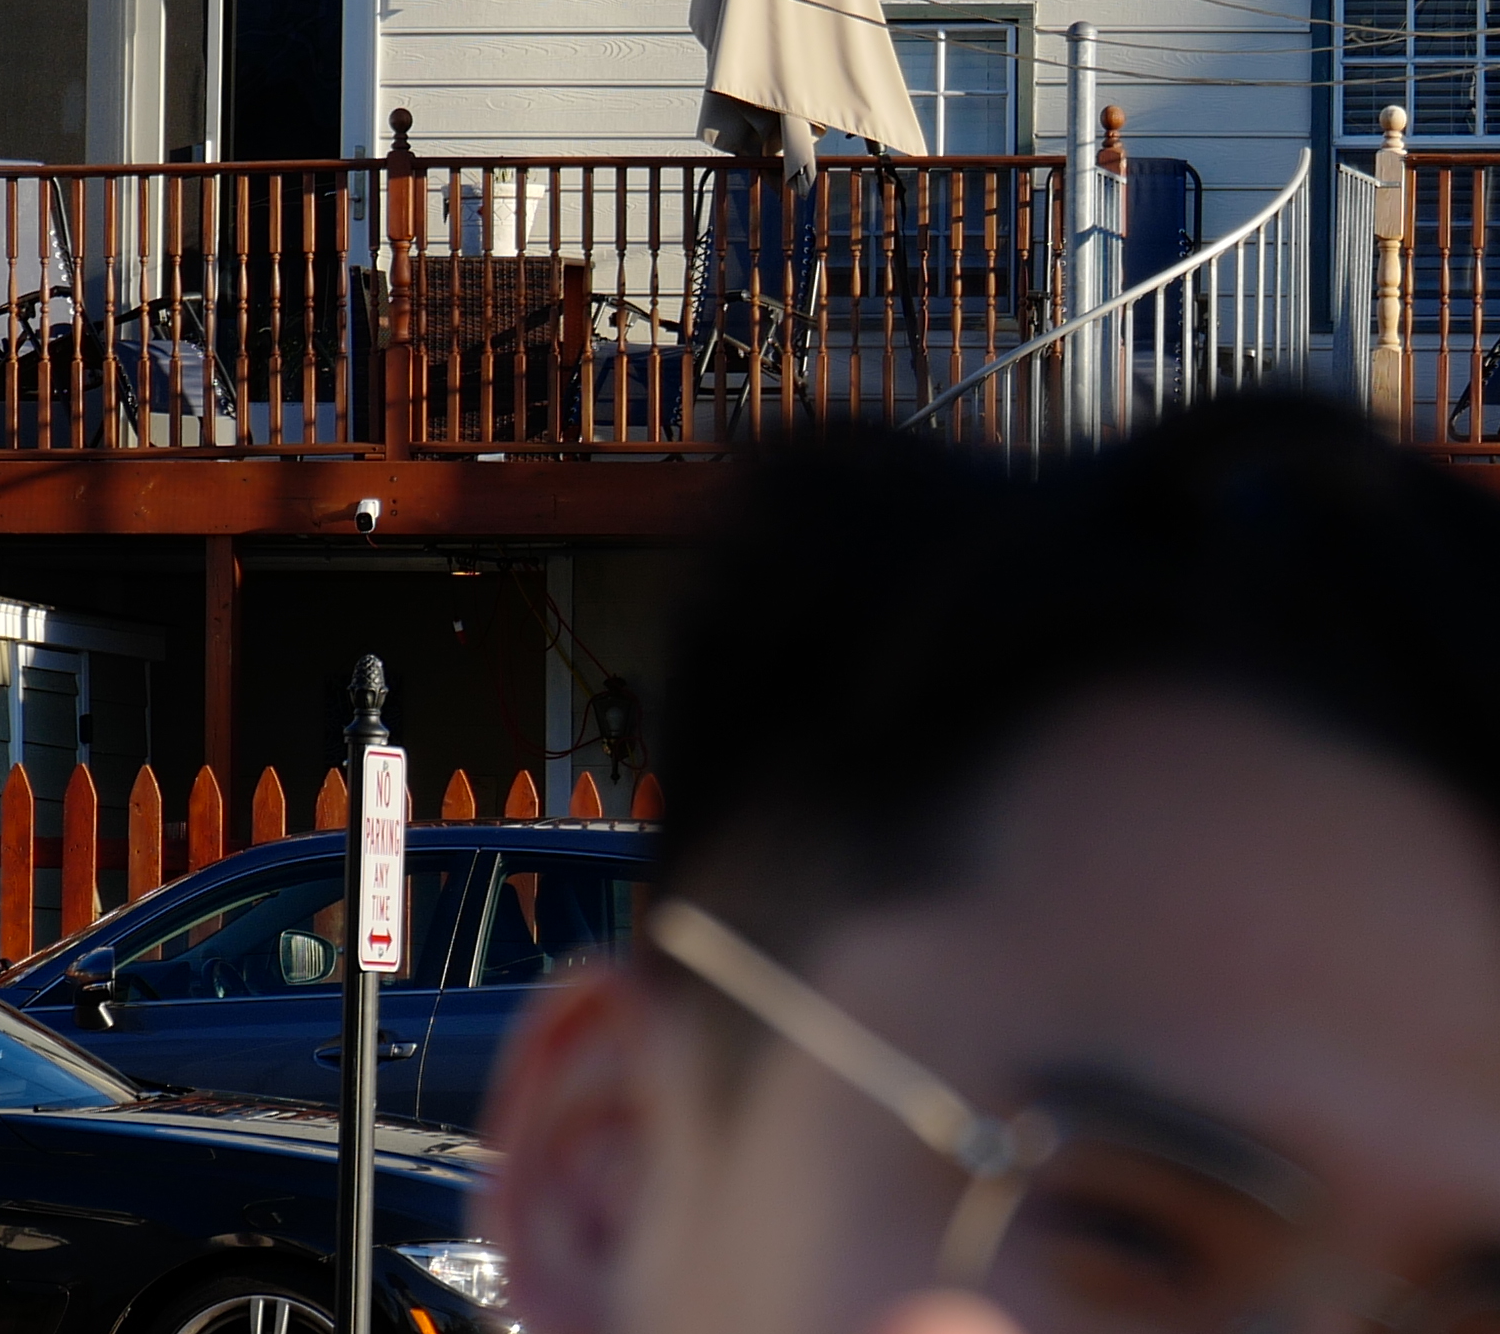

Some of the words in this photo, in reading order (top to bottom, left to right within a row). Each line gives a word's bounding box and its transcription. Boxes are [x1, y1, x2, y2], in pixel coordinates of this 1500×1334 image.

[376, 770, 391, 808] NO
[366, 817, 400, 857] PARKING
[373, 862, 390, 889] ANY
[371, 894, 391, 922] TIME
